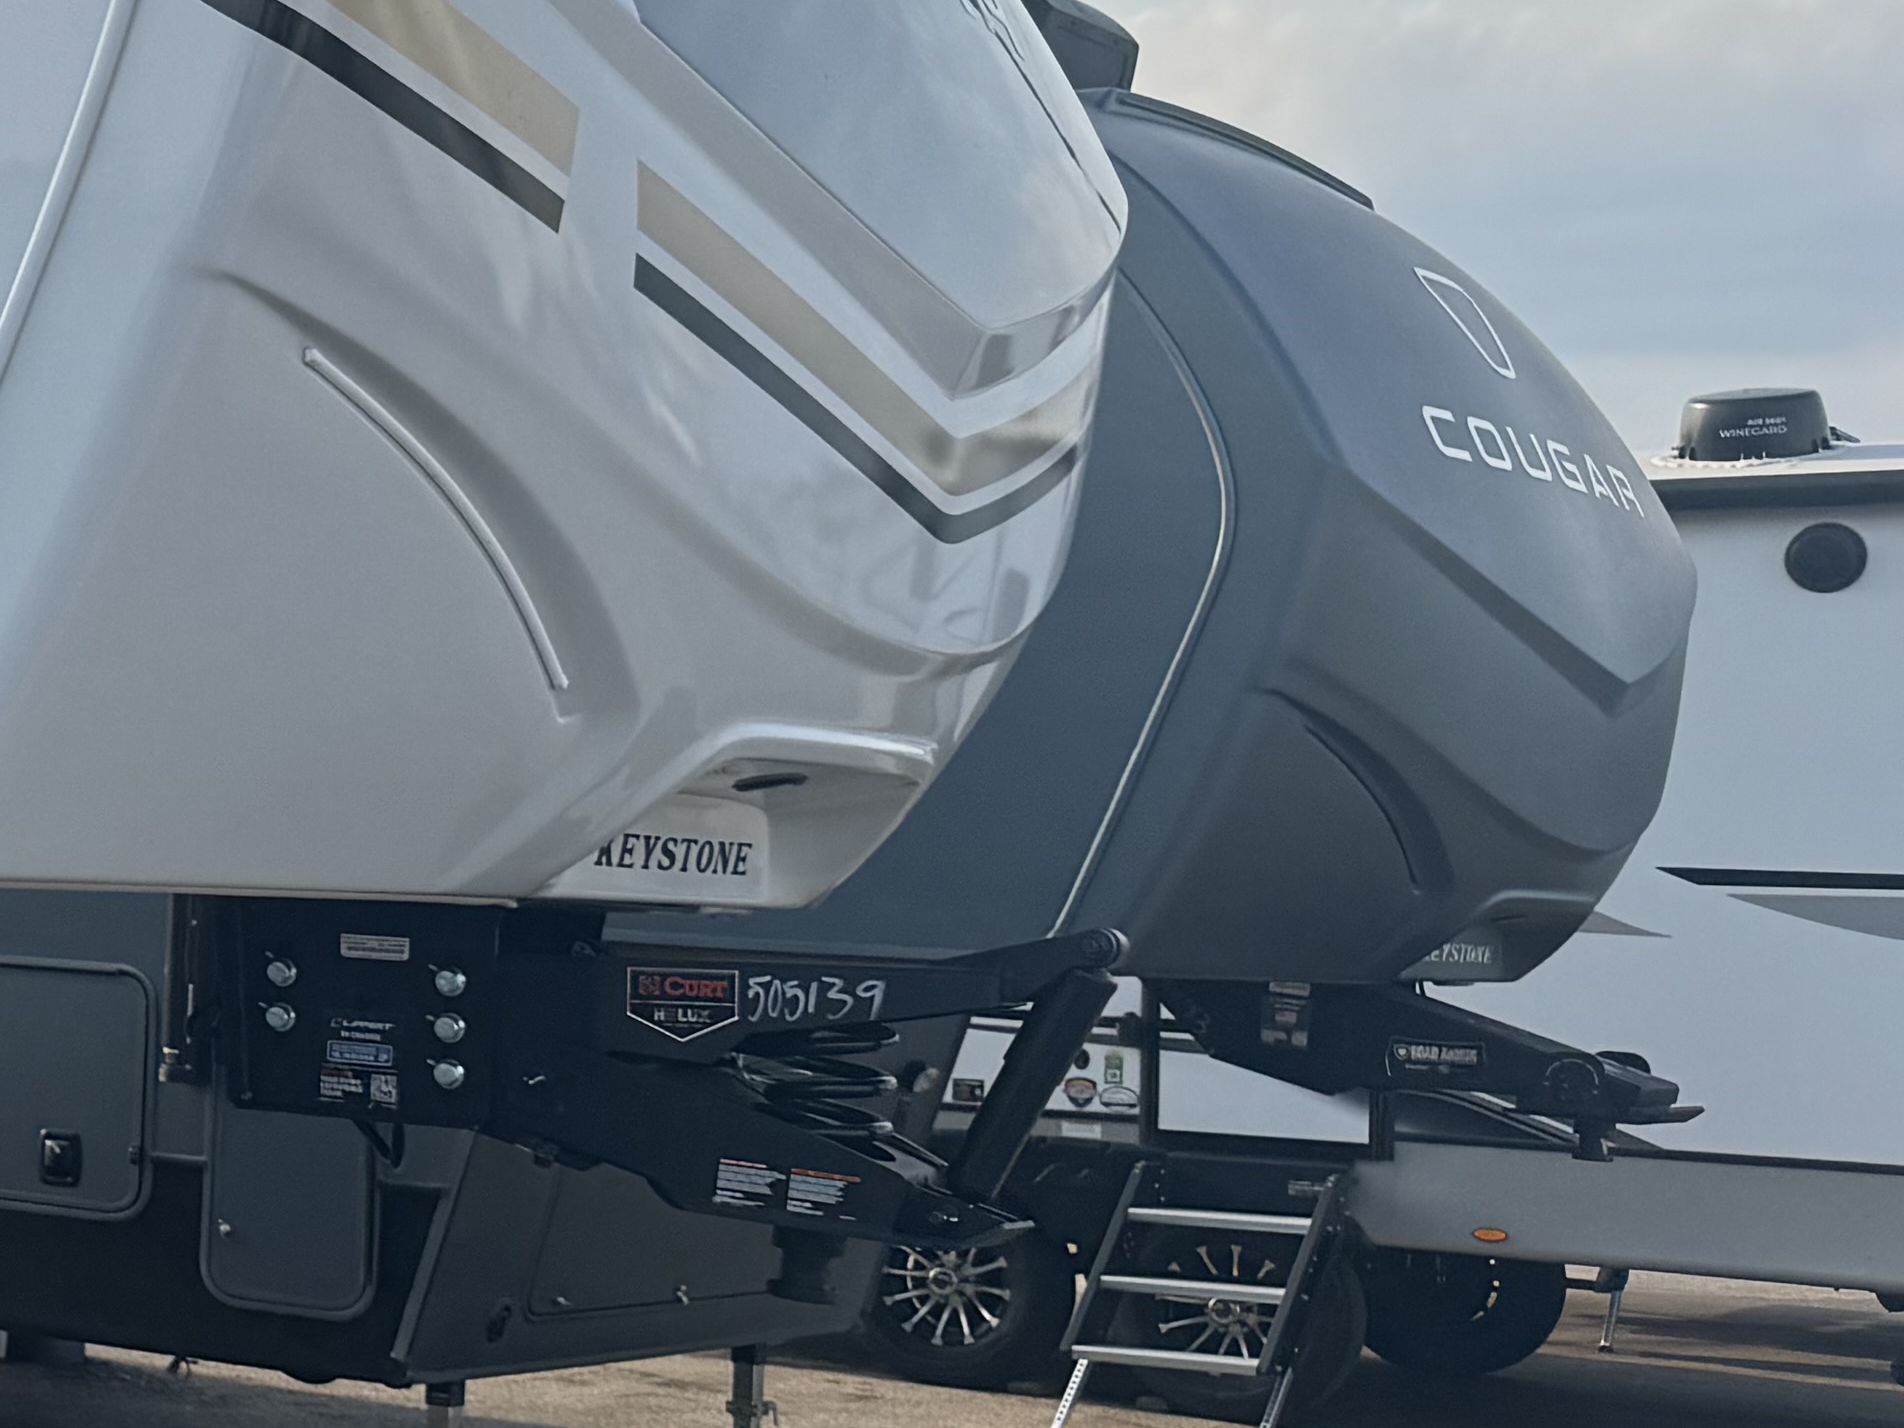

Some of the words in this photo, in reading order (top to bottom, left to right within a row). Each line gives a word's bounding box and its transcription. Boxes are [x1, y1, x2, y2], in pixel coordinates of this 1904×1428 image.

[1719, 425, 1788, 438] WINEGARD
[1422, 405, 1645, 518] COUGAR
[1423, 943, 1492, 964] EYSTONE
[664, 976, 728, 998] CURT
[747, 975, 886, 1022] 505139
[653, 1007, 711, 1023] HELUX
